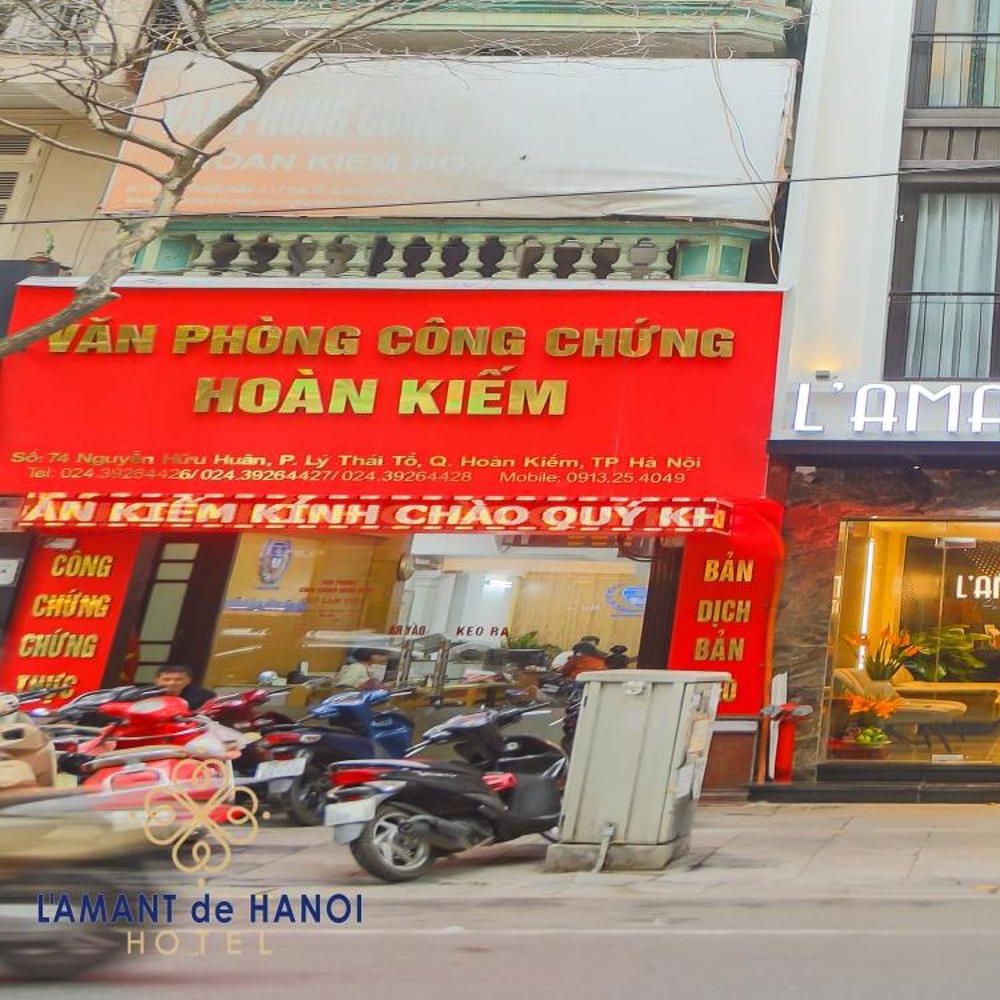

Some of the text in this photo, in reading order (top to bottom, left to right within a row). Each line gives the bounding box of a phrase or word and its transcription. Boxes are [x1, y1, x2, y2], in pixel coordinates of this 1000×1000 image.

[48, 315, 735, 359] VĂN PHÒNG CÔNG CHỨNG
[192, 365, 568, 416] HOÀN KIẾM
[49, 452, 69, 463] 74
[394, 499, 530, 527] CHÀO
[540, 501, 647, 530] QUÝ
[51, 549, 113, 578] CÔNG
[703, 551, 754, 583] BẢN
[31, 589, 112, 618] CHỨNG
[696, 600, 751, 628] DỊCH
[18, 628, 99, 659] CHỨNG
[693, 629, 746, 662] BẢN
